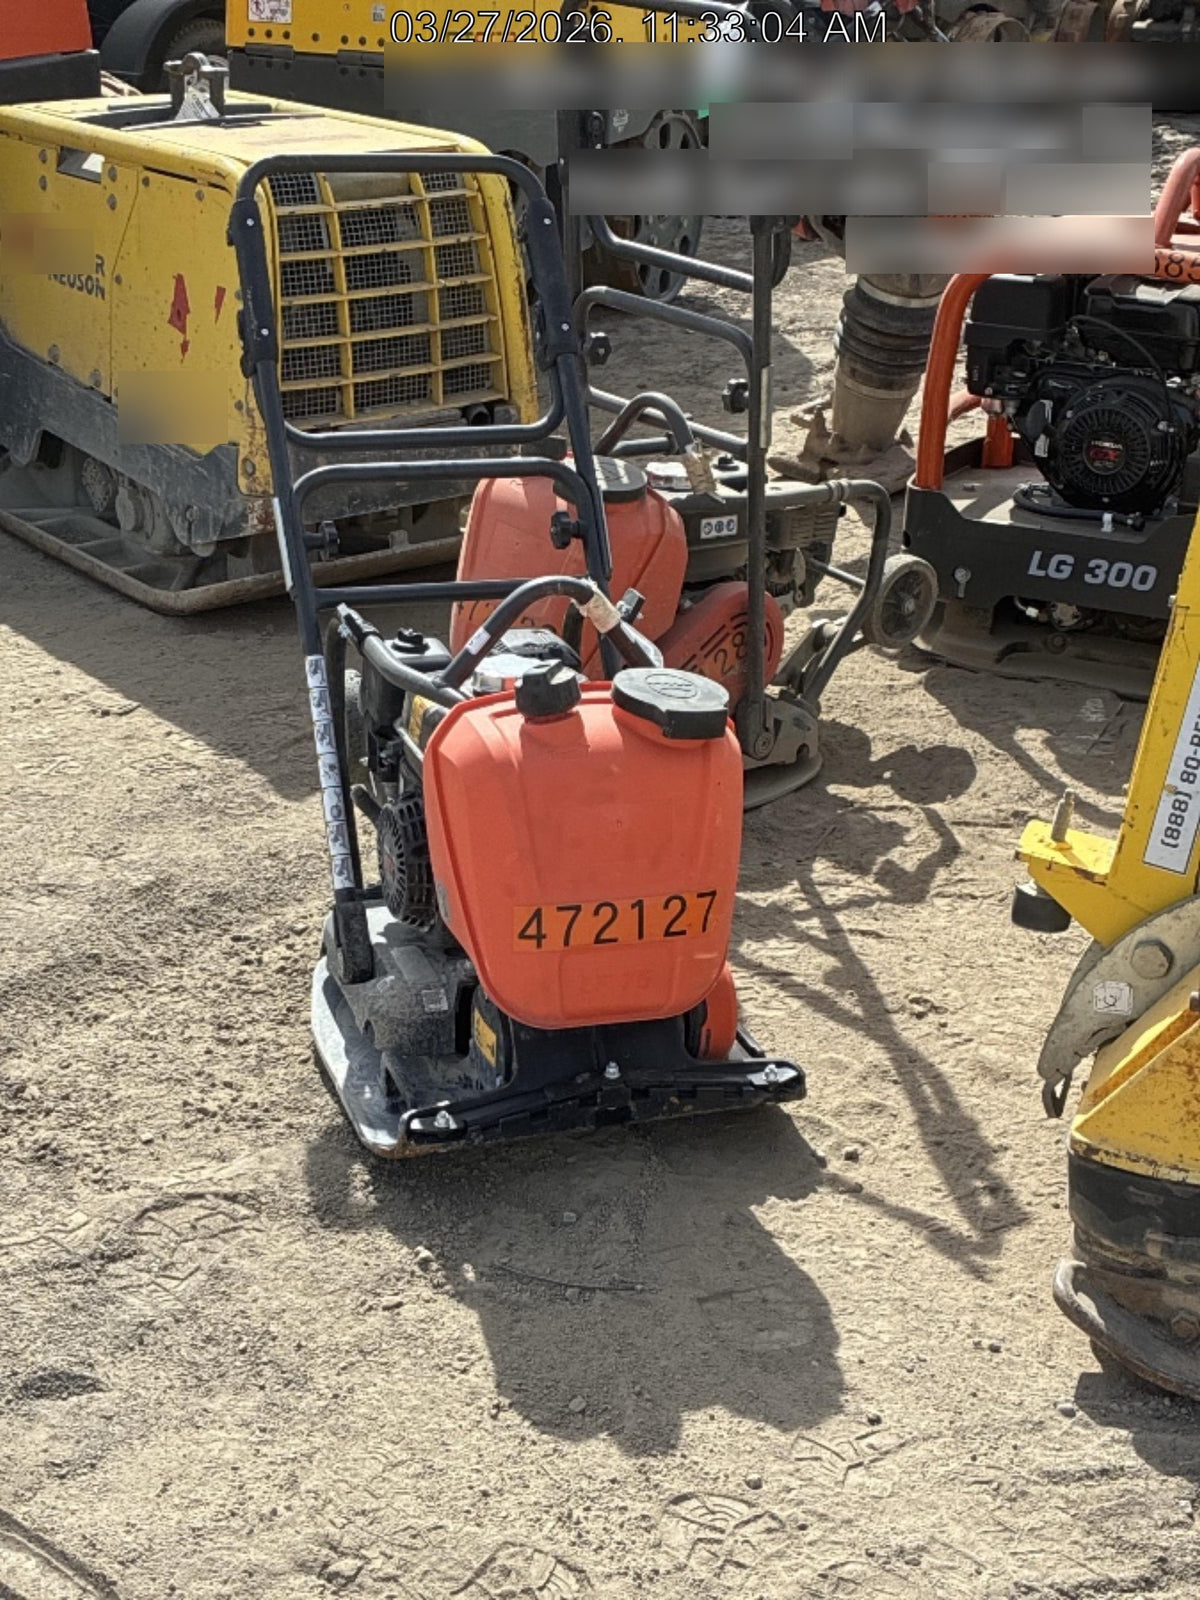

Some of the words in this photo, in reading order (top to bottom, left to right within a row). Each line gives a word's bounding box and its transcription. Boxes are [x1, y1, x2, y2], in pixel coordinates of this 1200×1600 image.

[1027, 550, 1075, 580] LG
[1084, 558, 1158, 591] 300
[1160, 790, 1192, 849] (888)
[517, 890, 717, 949] 472127
